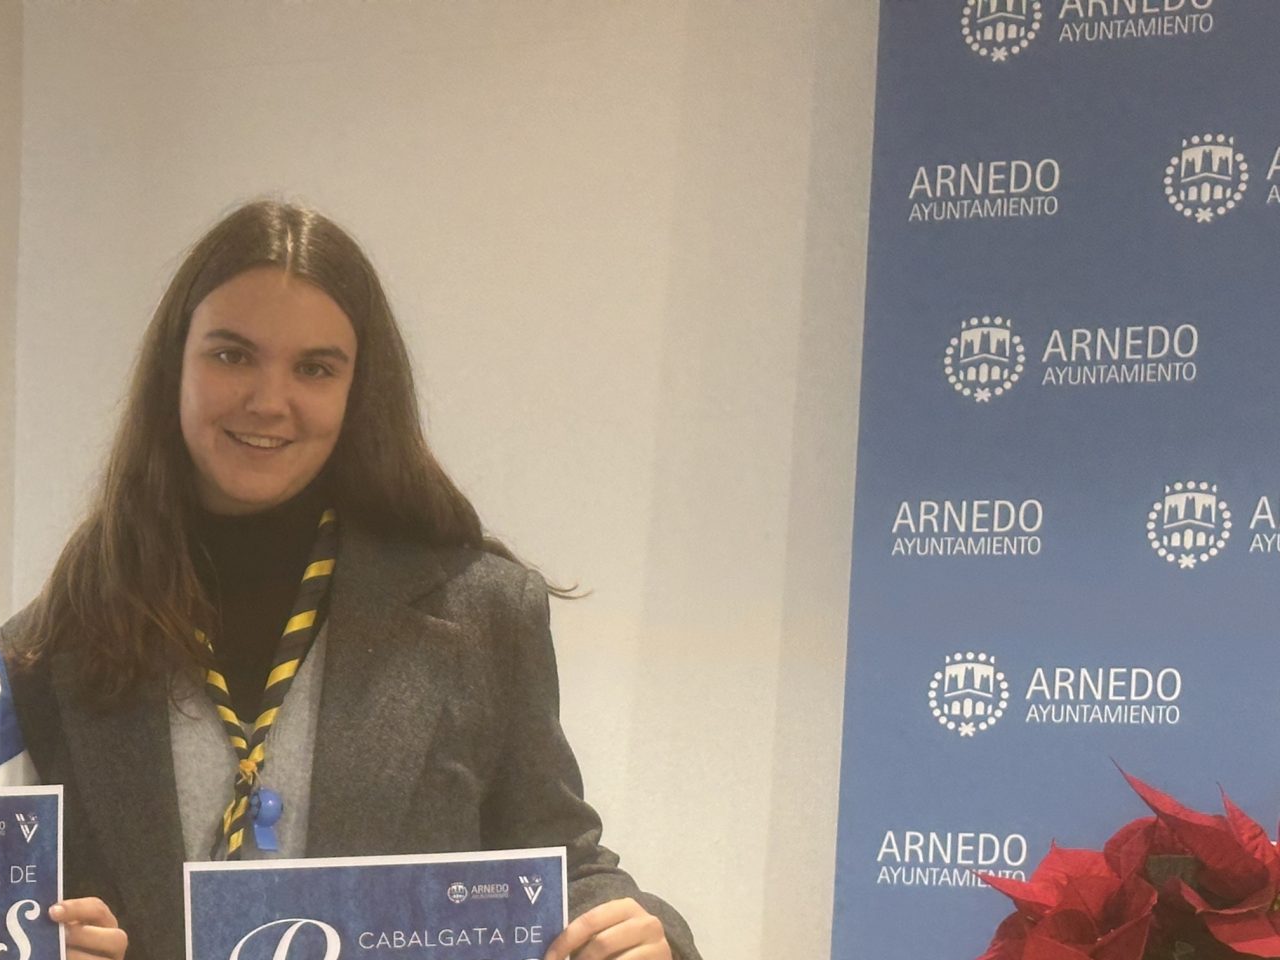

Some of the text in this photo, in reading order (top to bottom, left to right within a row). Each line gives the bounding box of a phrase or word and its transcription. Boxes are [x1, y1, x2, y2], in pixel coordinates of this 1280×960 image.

[1058, 12, 1215, 42] AYUNTAMIENTO
[908, 158, 1061, 199] ARNEDO
[908, 195, 1059, 221] AYUNTAMIENTO
[1041, 323, 1199, 362] ARNEDO
[1041, 361, 1197, 386] AYUNTAMIENTO
[891, 499, 1044, 533] ARNEDO
[891, 535, 1042, 556] AYUNTAMIENTO
[1025, 667, 1182, 701] ARNEDO
[1025, 703, 1180, 725] AYUNTAMIENTO
[876, 830, 1027, 867] ARNEDO
[10, 864, 37, 884] DE
[471, 882, 509, 894] ARNEDO
[358, 925, 543, 950] CABALGATA DE
